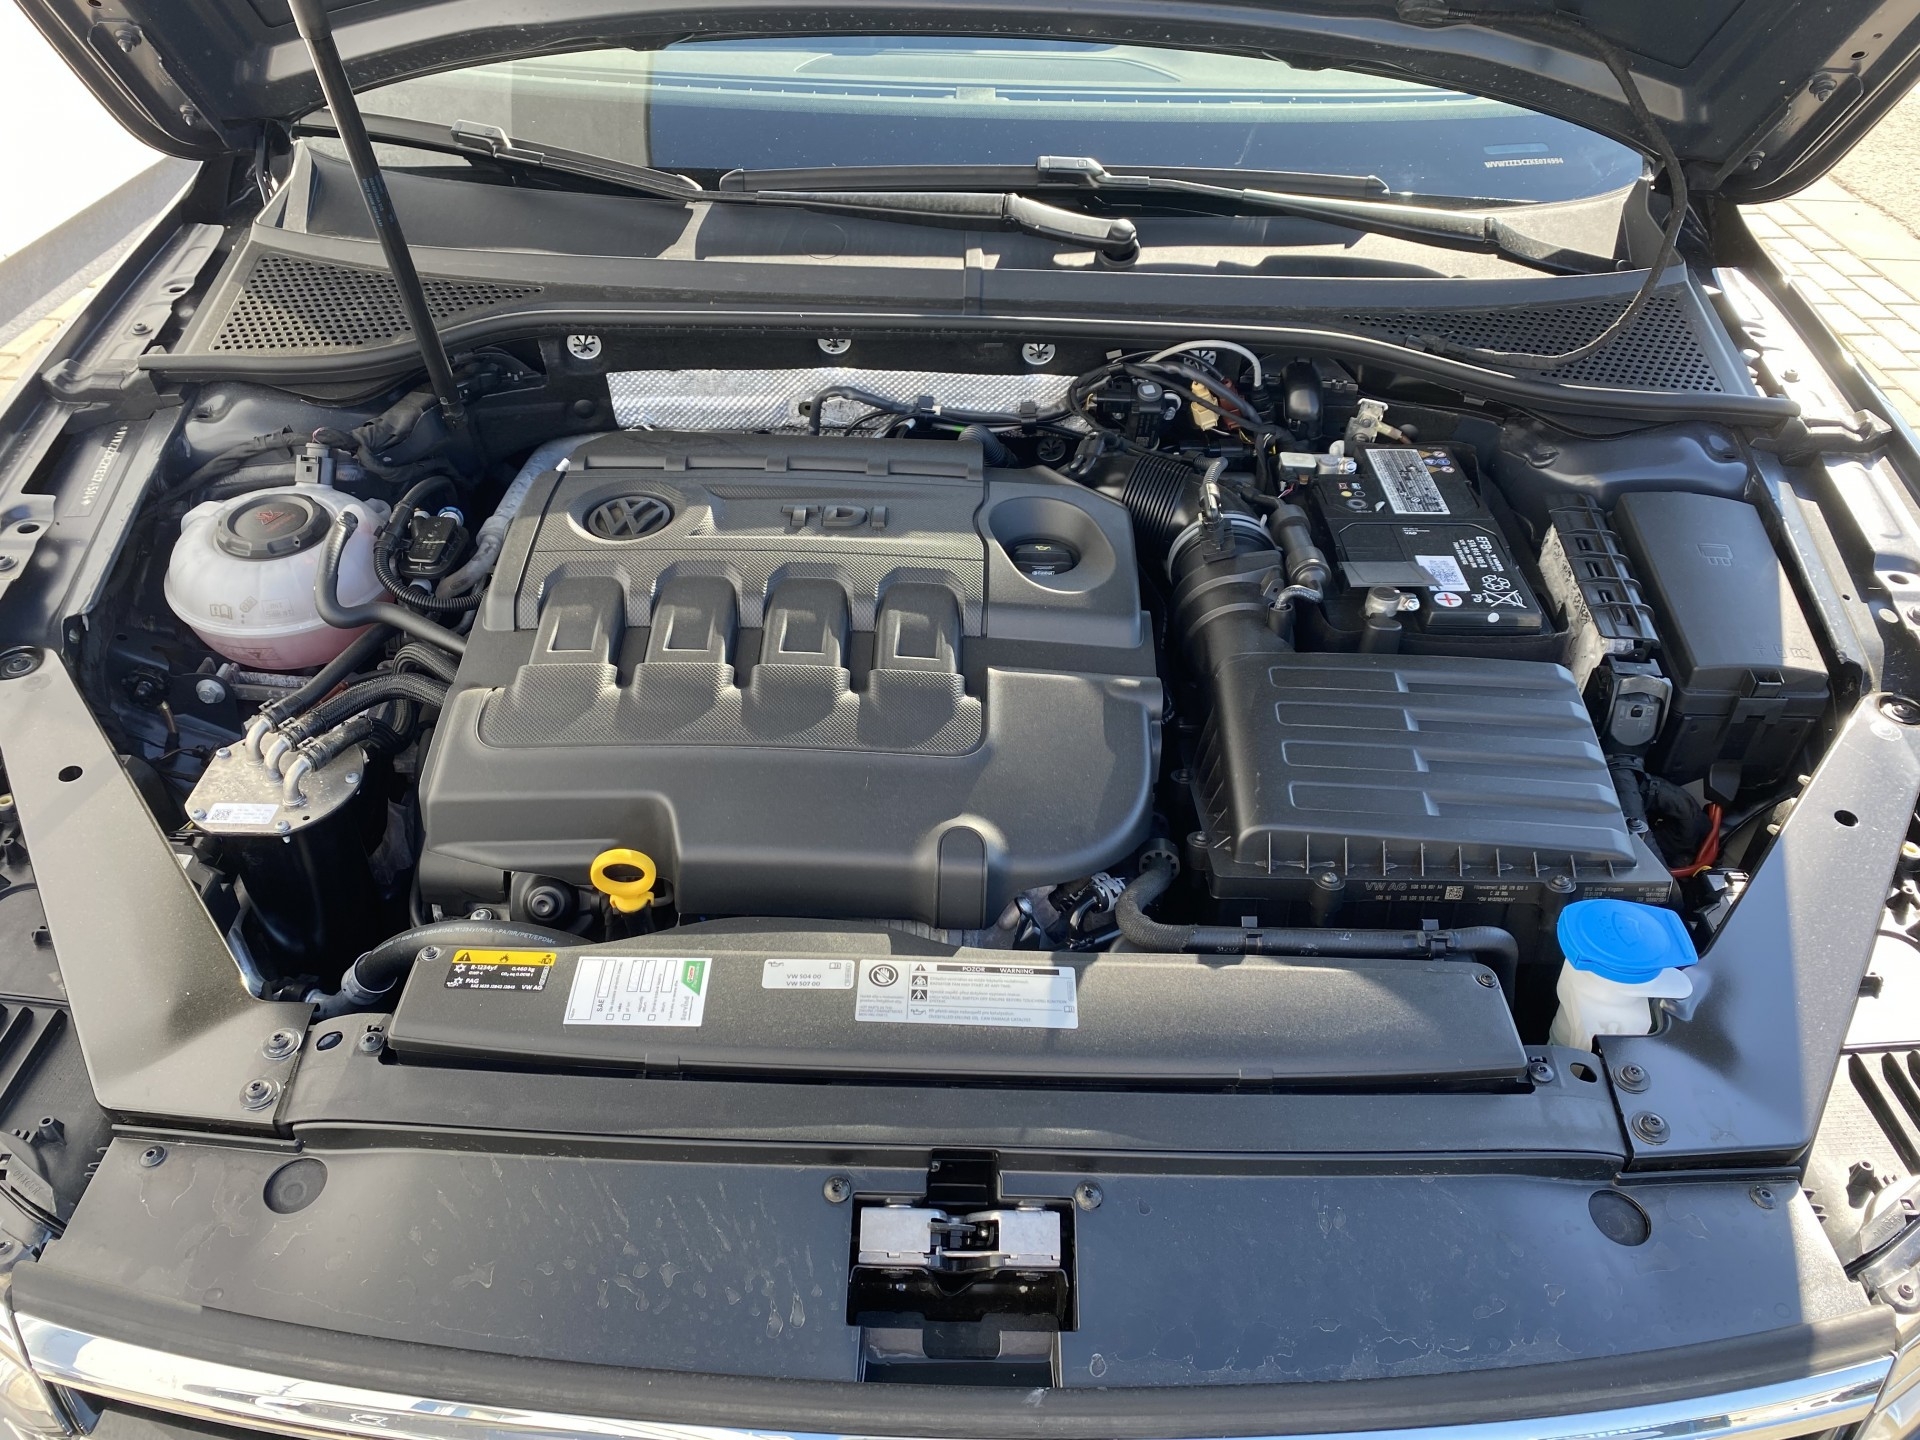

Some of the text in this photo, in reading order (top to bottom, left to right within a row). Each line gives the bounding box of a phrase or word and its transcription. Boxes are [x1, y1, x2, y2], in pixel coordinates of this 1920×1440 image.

[588, 496, 671, 539] VW
[781, 503, 889, 528] TDI
[1471, 594, 1483, 602] Pb
[1364, 882, 1407, 891] VW AG
[596, 999, 604, 1012] SAE
